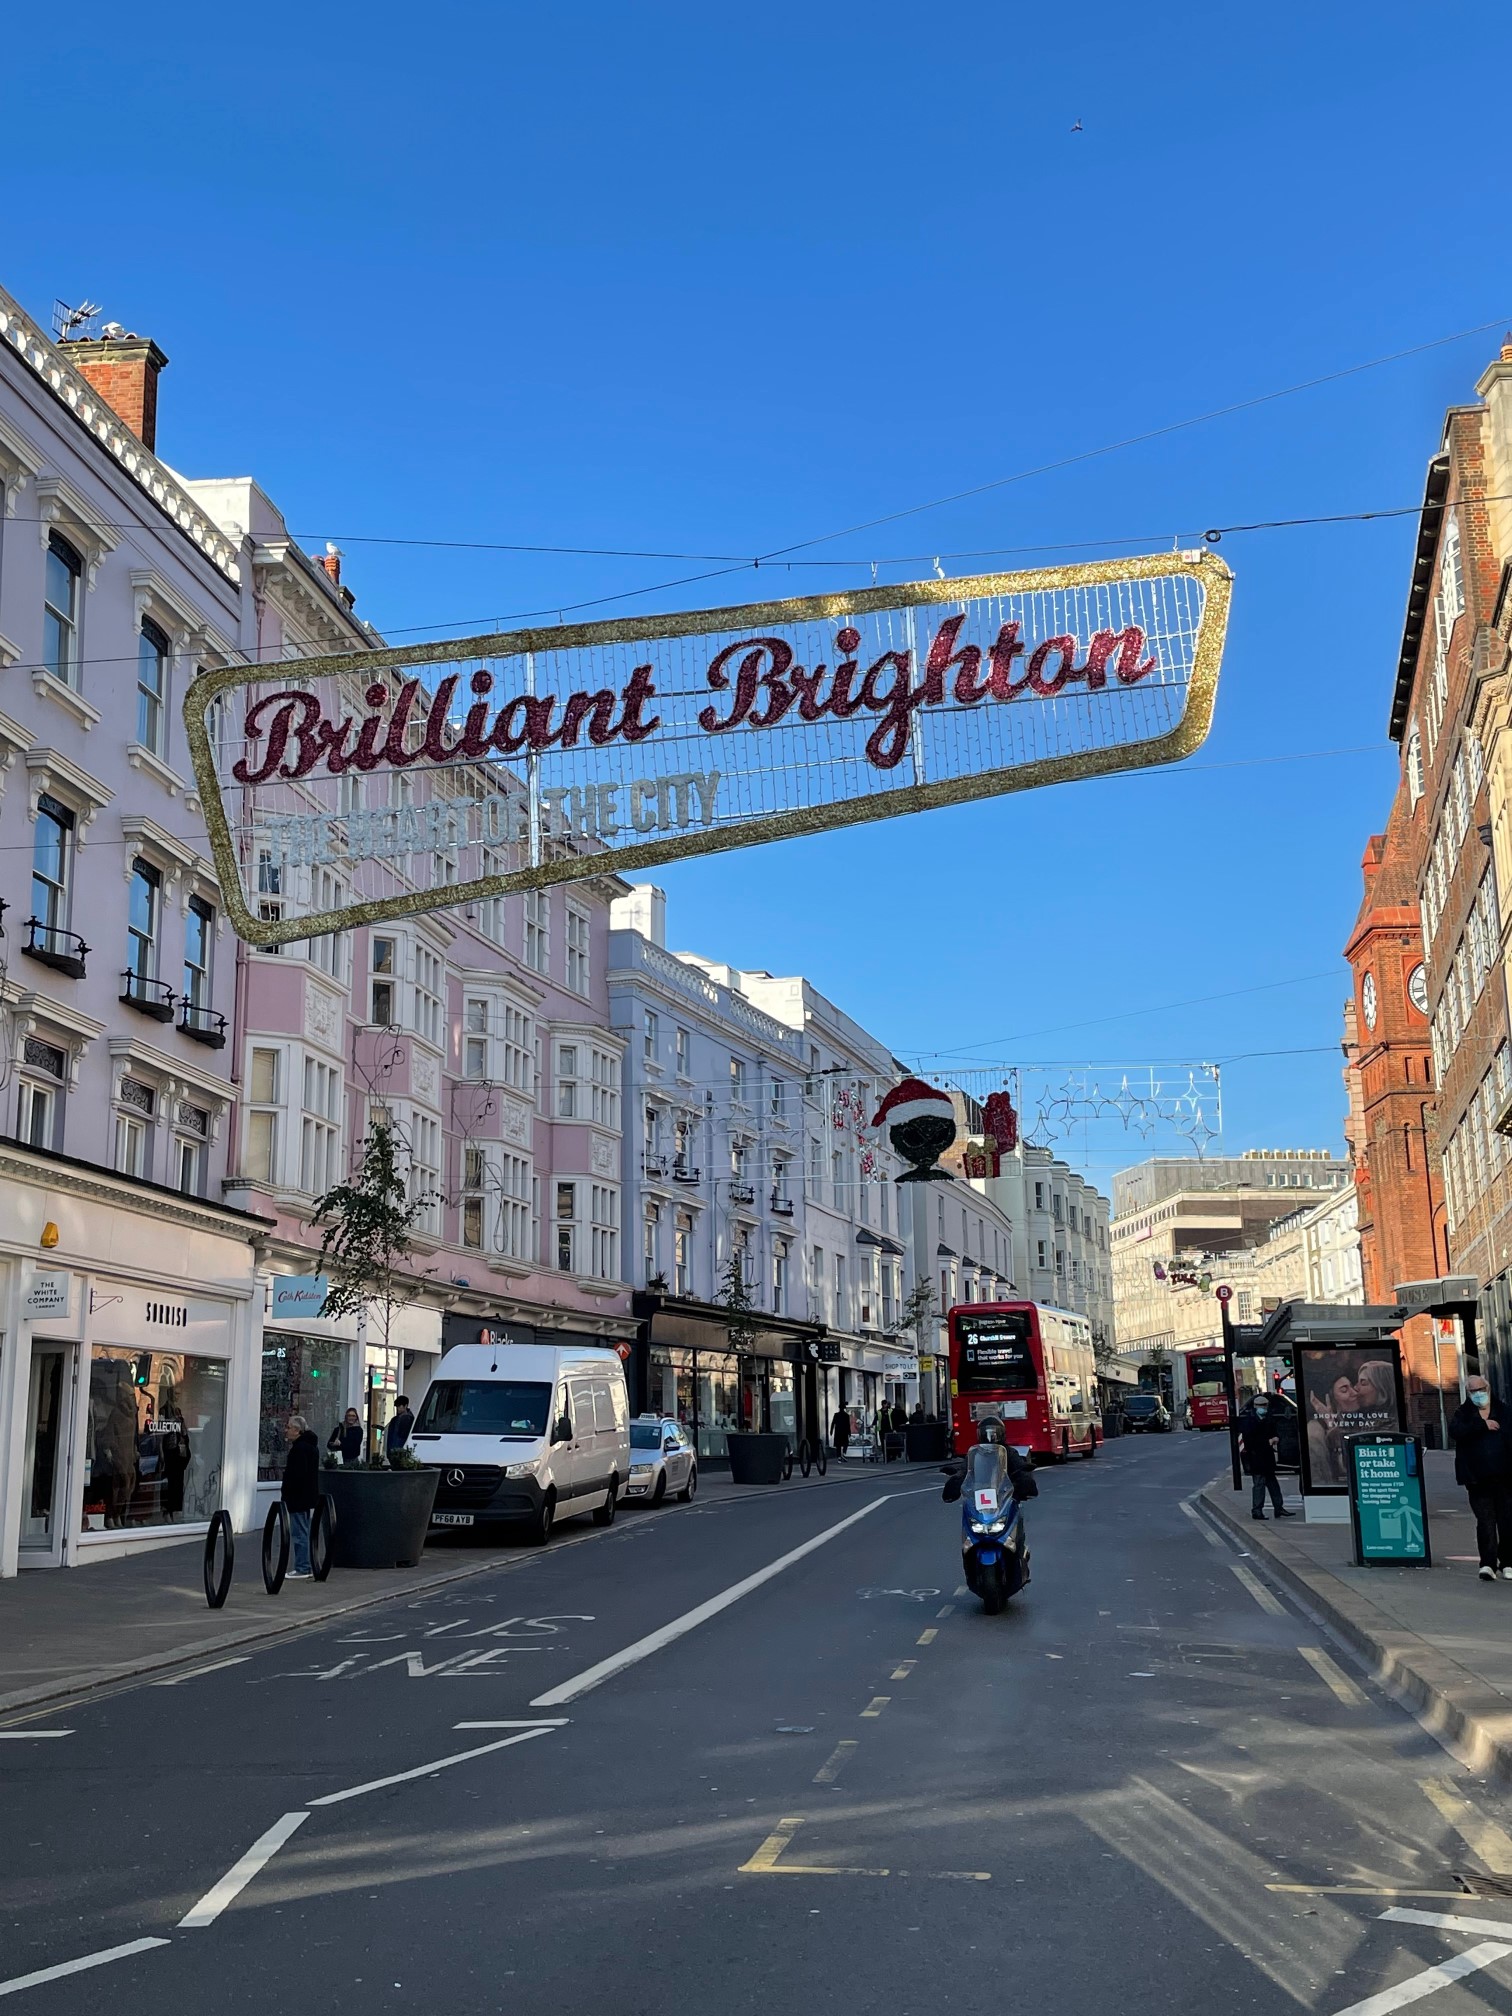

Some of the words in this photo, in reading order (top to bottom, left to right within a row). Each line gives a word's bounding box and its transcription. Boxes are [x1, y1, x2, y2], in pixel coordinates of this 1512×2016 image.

[234, 664, 660, 784] Brilliant
[699, 613, 1157, 769] Brighton
[265, 813, 337, 869] THE
[349, 796, 475, 861] HEART
[482, 791, 528, 846] OF
[543, 782, 619, 840] THE
[631, 770, 721, 833] CITY
[278, 1290, 293, 1303] Cath
[1220, 1288, 1228, 1298] B
[27, 1296, 65, 1304] COMPANY
[490, 1330, 513, 1345] Blacks
[967, 1333, 978, 1345] 26
[1342, 1412, 1365, 1420] YOUR
[149, 1420, 182, 1432] COLLECTION
[1358, 1447, 1377, 1458] Bin
[1378, 1447, 1387, 1458] it
[1360, 1460, 1371, 1468] or
[1372, 1458, 1396, 1468] take
[1360, 1469, 1369, 1478] it
[1370, 1469, 1400, 1478] home
[980, 1493, 992, 1505] L
